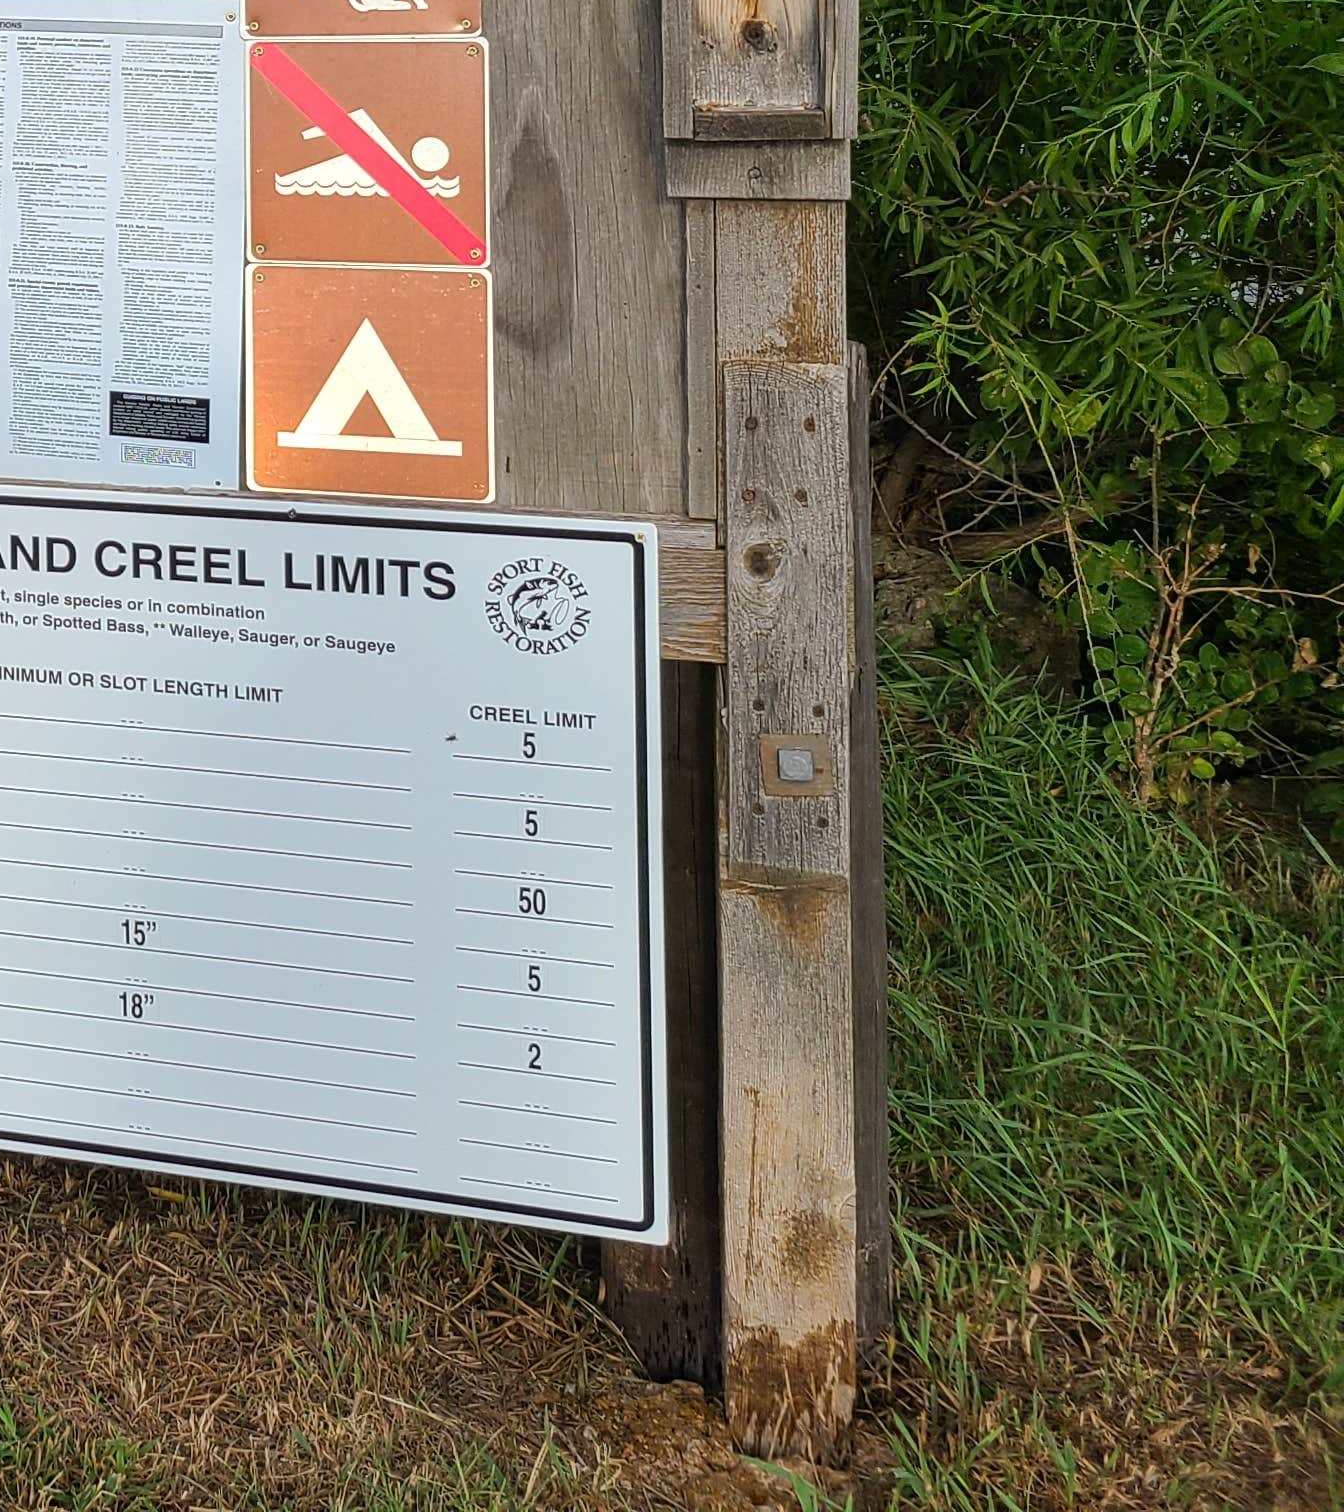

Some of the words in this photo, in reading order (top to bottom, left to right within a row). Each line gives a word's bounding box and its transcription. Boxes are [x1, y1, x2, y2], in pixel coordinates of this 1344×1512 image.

[94, 540, 265, 587] CREEL
[284, 552, 457, 600] LIMITS
[488, 558, 544, 596] SPORT
[548, 561, 589, 600] FISH
[14, 590, 60, 607] single
[64, 594, 122, 612] species
[127, 600, 144, 612] or
[148, 598, 162, 613] in
[166, 600, 265, 620] combination
[22, 614, 38, 626] or
[42, 614, 102, 630] Spotted
[106, 619, 150, 636] Bass,
[170, 623, 234, 644] Walleye,
[238, 628, 300, 648] Sauger,
[304, 636, 320, 648] or
[325, 635, 396, 654] Saugeye
[485, 600, 592, 655] RESTORATION
[68, 672, 94, 688] OR
[100, 674, 148, 692] SLOT
[153, 678, 228, 699] LENGTH
[234, 685, 283, 704] LIMIT
[470, 705, 538, 725] CREEL
[544, 711, 596, 730] LIMIT
[522, 732, 536, 758] 5
[524, 810, 538, 836] 5
[518, 886, 546, 916] 50
[528, 964, 542, 992] 5
[528, 1042, 542, 1070] 2
